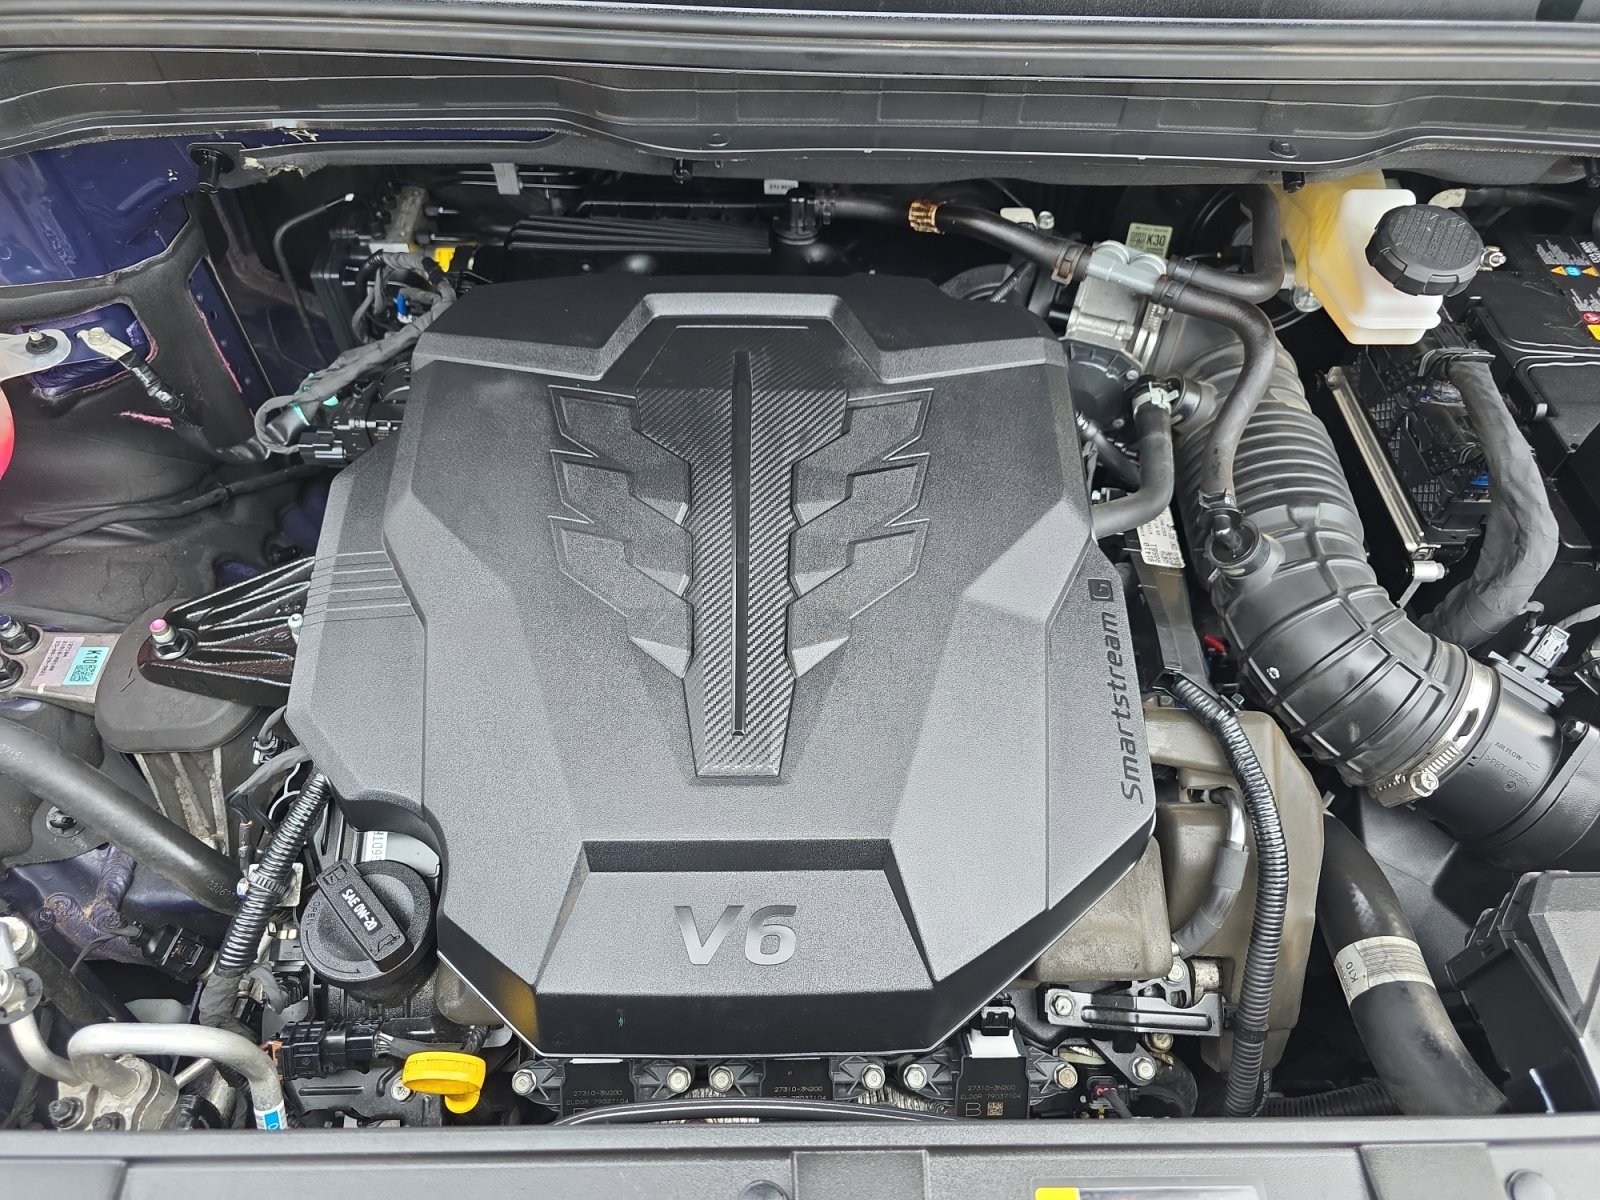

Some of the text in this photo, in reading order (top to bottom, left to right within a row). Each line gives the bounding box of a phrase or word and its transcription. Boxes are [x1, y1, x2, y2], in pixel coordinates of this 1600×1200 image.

[1146, 233, 1166, 247] K30
[83, 649, 102, 664] K10
[1101, 611, 1144, 804] Smartstream
[1505, 747, 1523, 761] FLOW
[341, 888, 360, 908] SAE
[306, 901, 321, 927] OPEN
[674, 904, 798, 967] V6
[1345, 961, 1359, 984] K10
[967, 1084, 1016, 1092] 27310-3N200
[965, 1102, 982, 1117] B
